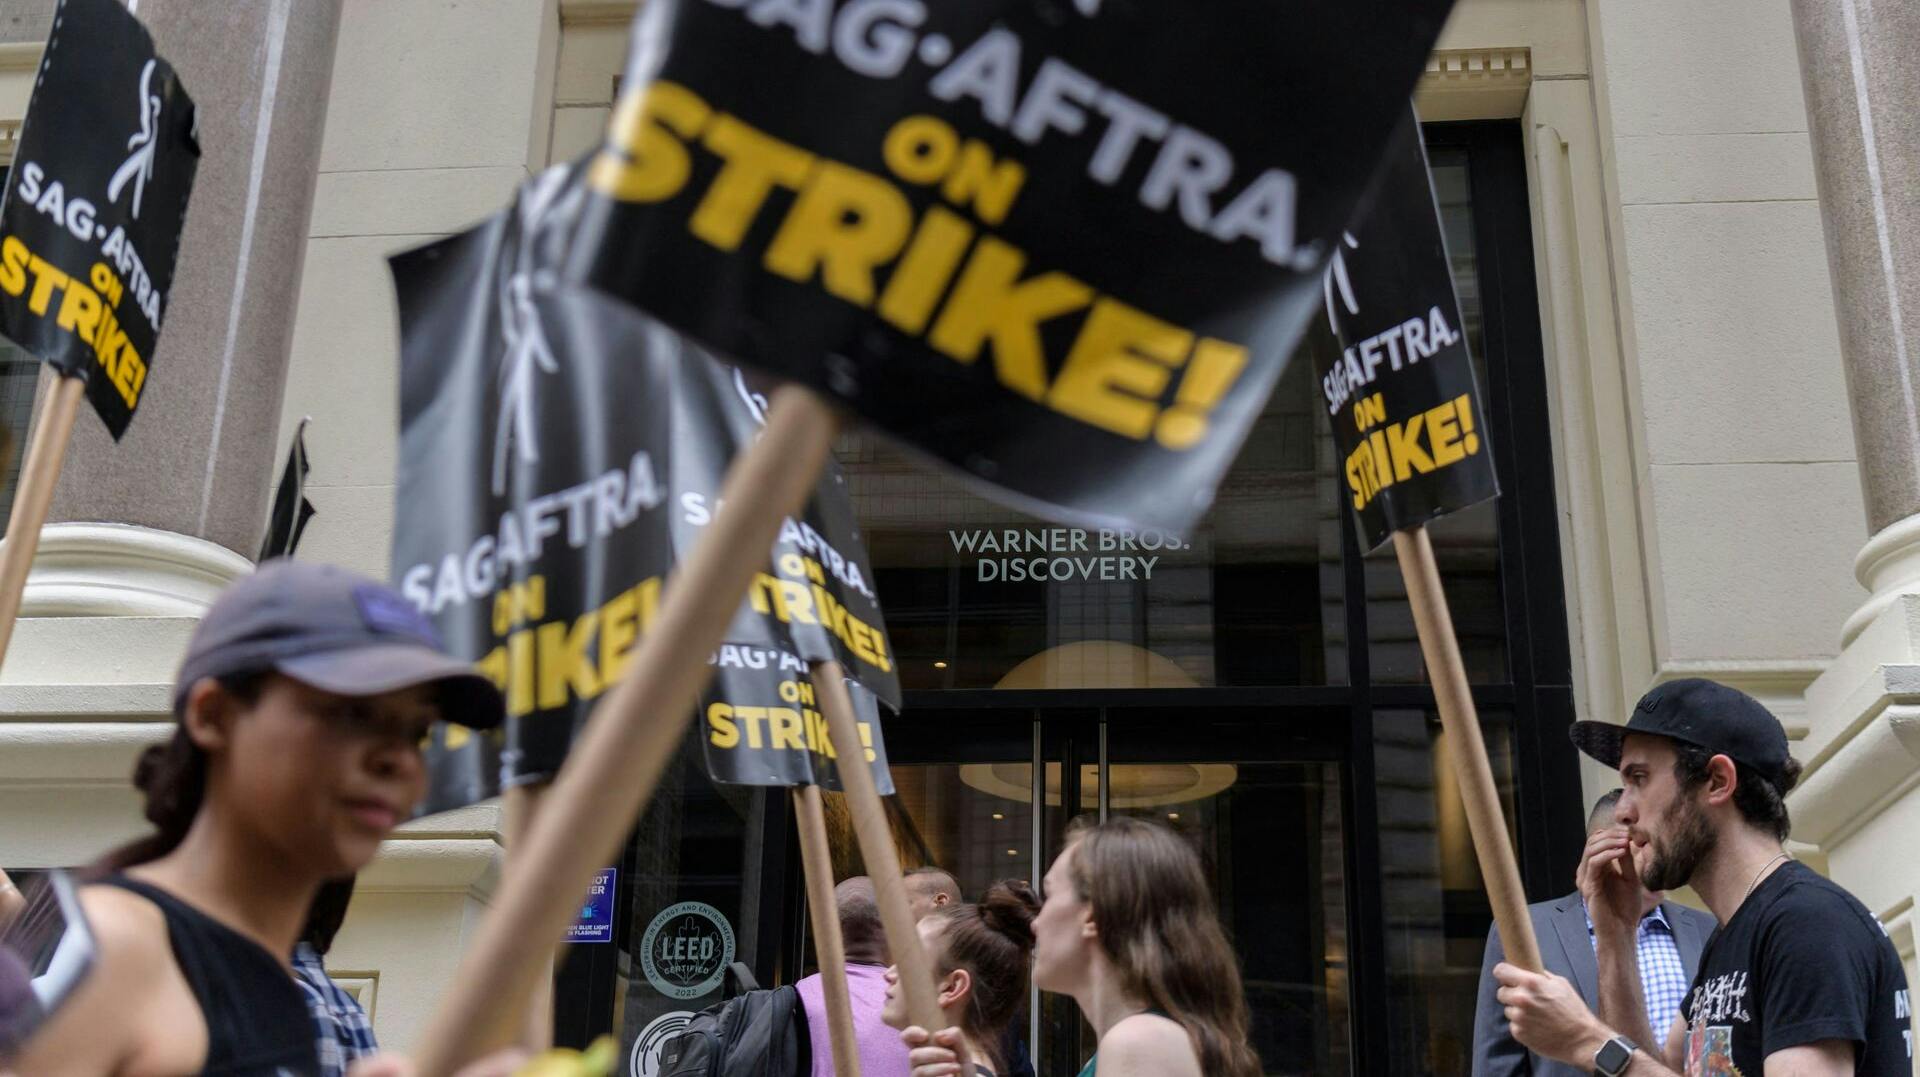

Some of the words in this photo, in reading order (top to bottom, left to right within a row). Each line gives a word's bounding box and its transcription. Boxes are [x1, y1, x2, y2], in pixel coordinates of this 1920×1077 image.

[883, 115, 1028, 226] ON
[90, 262, 123, 309] ON
[588, 79, 1250, 451] STRIKE!
[0, 235, 147, 410] STRIKE!
[1354, 392, 1388, 433] ON
[1346, 393, 1480, 510] STRIKE!
[949, 528, 1089, 553] WARNER
[1099, 528, 1191, 551] BROS.
[779, 553, 826, 586] ON
[978, 556, 1159, 582] DISCOVERY
[492, 574, 545, 636] ON
[749, 571, 892, 673] TRIKE!
[779, 680, 815, 706] ON
[707, 702, 876, 763] STRIK!
[681, 904, 697, 912] AND
[662, 936, 714, 960] LEED
[664, 964, 710, 975] CERTIFIED
[675, 988, 697, 997] 2022
